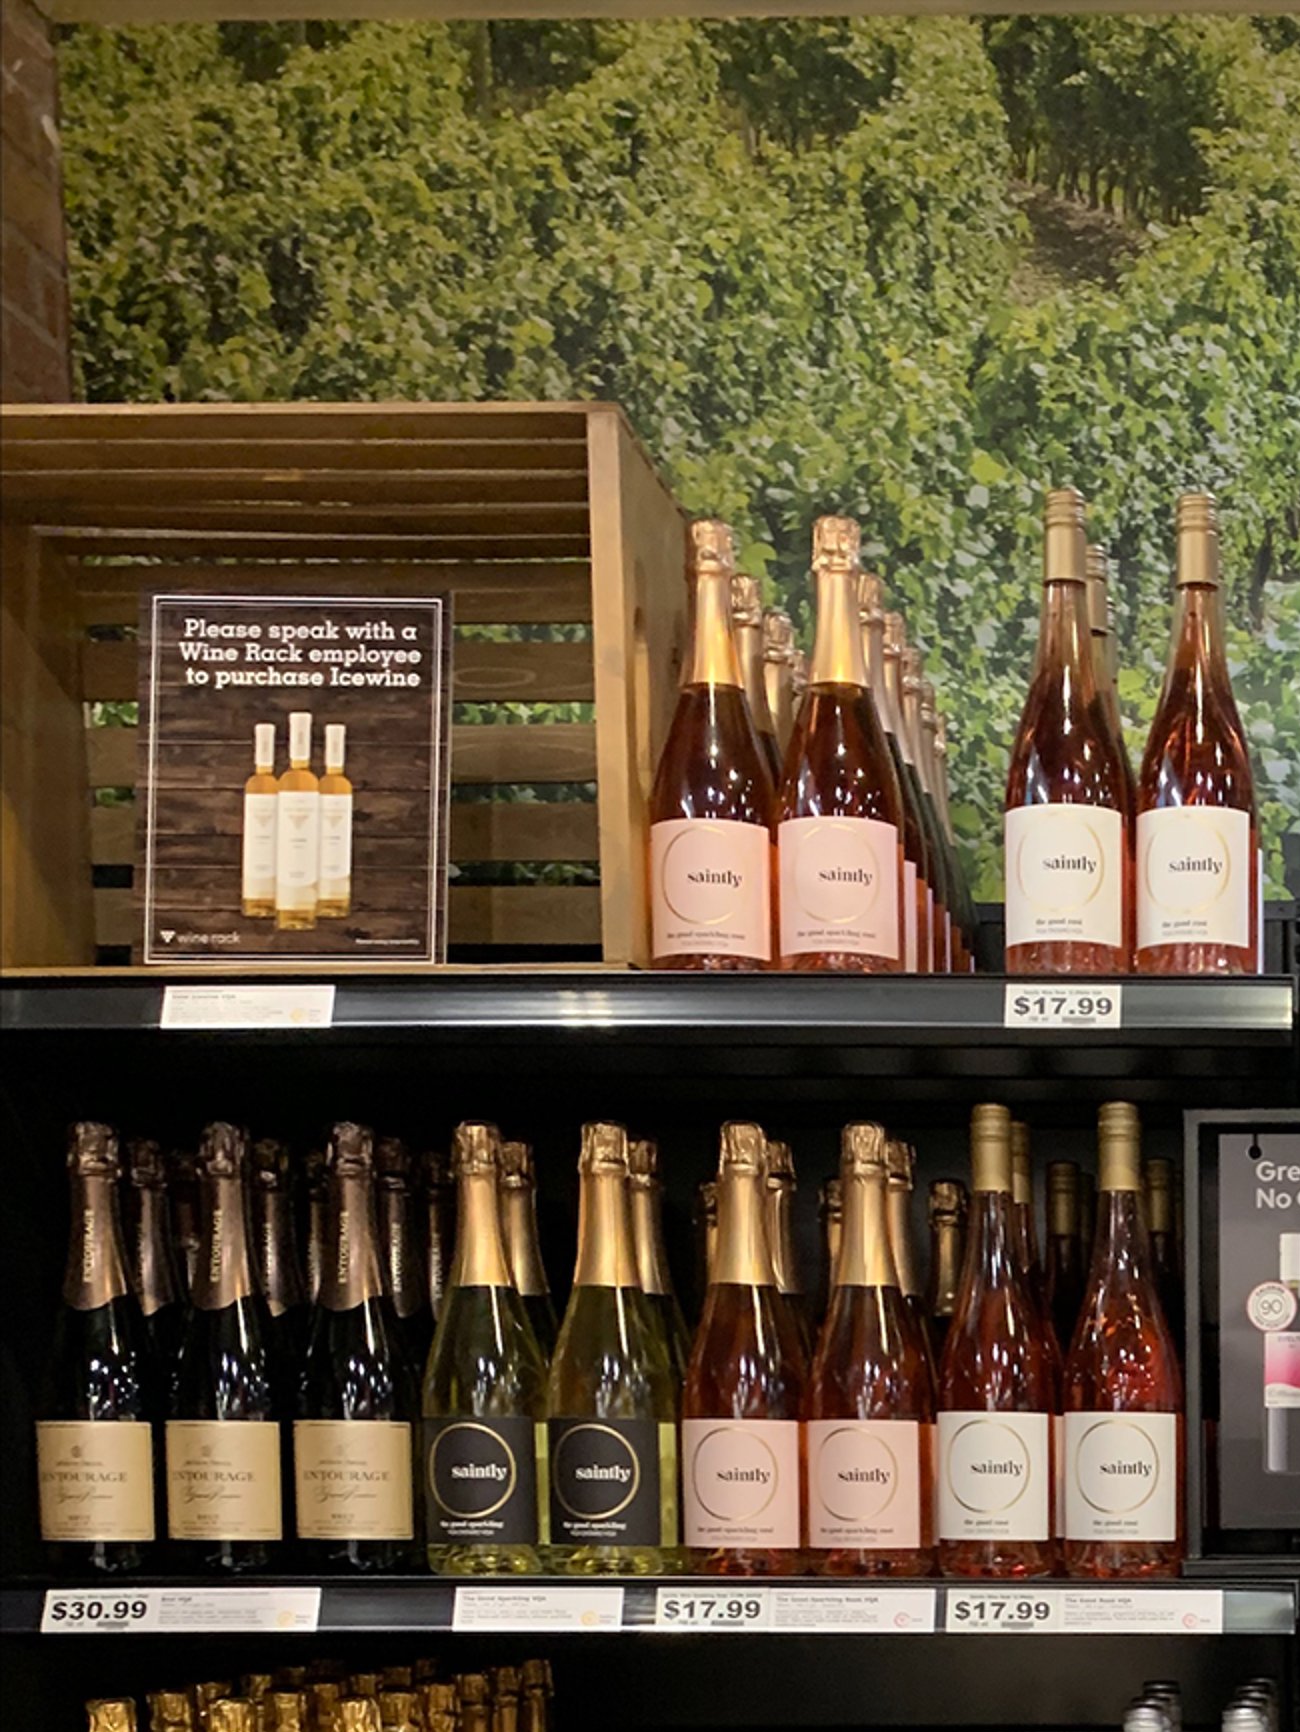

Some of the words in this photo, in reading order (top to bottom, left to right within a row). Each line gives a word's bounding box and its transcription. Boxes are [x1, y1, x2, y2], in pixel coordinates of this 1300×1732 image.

[184, 618, 262, 639] Please
[268, 620, 340, 643] speak
[346, 621, 395, 640] with
[402, 625, 417, 640] a
[179, 642, 238, 662] Wine
[245, 643, 303, 663] Rack
[309, 645, 422, 667] employee
[186, 668, 209, 685] to
[215, 667, 324, 690] purchase
[330, 667, 421, 687] Icewine
[1042, 855, 1097, 873] saintly
[1168, 857, 1223, 875] saintly
[687, 868, 743, 888] saintly
[818, 867, 873, 888] saintly
[177, 932, 208, 944] wine
[210, 931, 241, 944] rack
[1013, 996, 1113, 1016] $17.99
[1256, 1188, 1291, 1209] No
[1260, 1299, 1283, 1316] 90
[451, 1463, 508, 1481] saintly
[575, 1464, 632, 1483] saintly
[717, 1467, 770, 1484] saintly
[837, 1467, 890, 1484] saintly
[970, 1460, 1023, 1477] saintly
[1100, 1460, 1152, 1477] saintly
[51, 1600, 148, 1620] $30.99
[663, 1600, 761, 1620] $17.99
[954, 1601, 1050, 1620] $17.99
